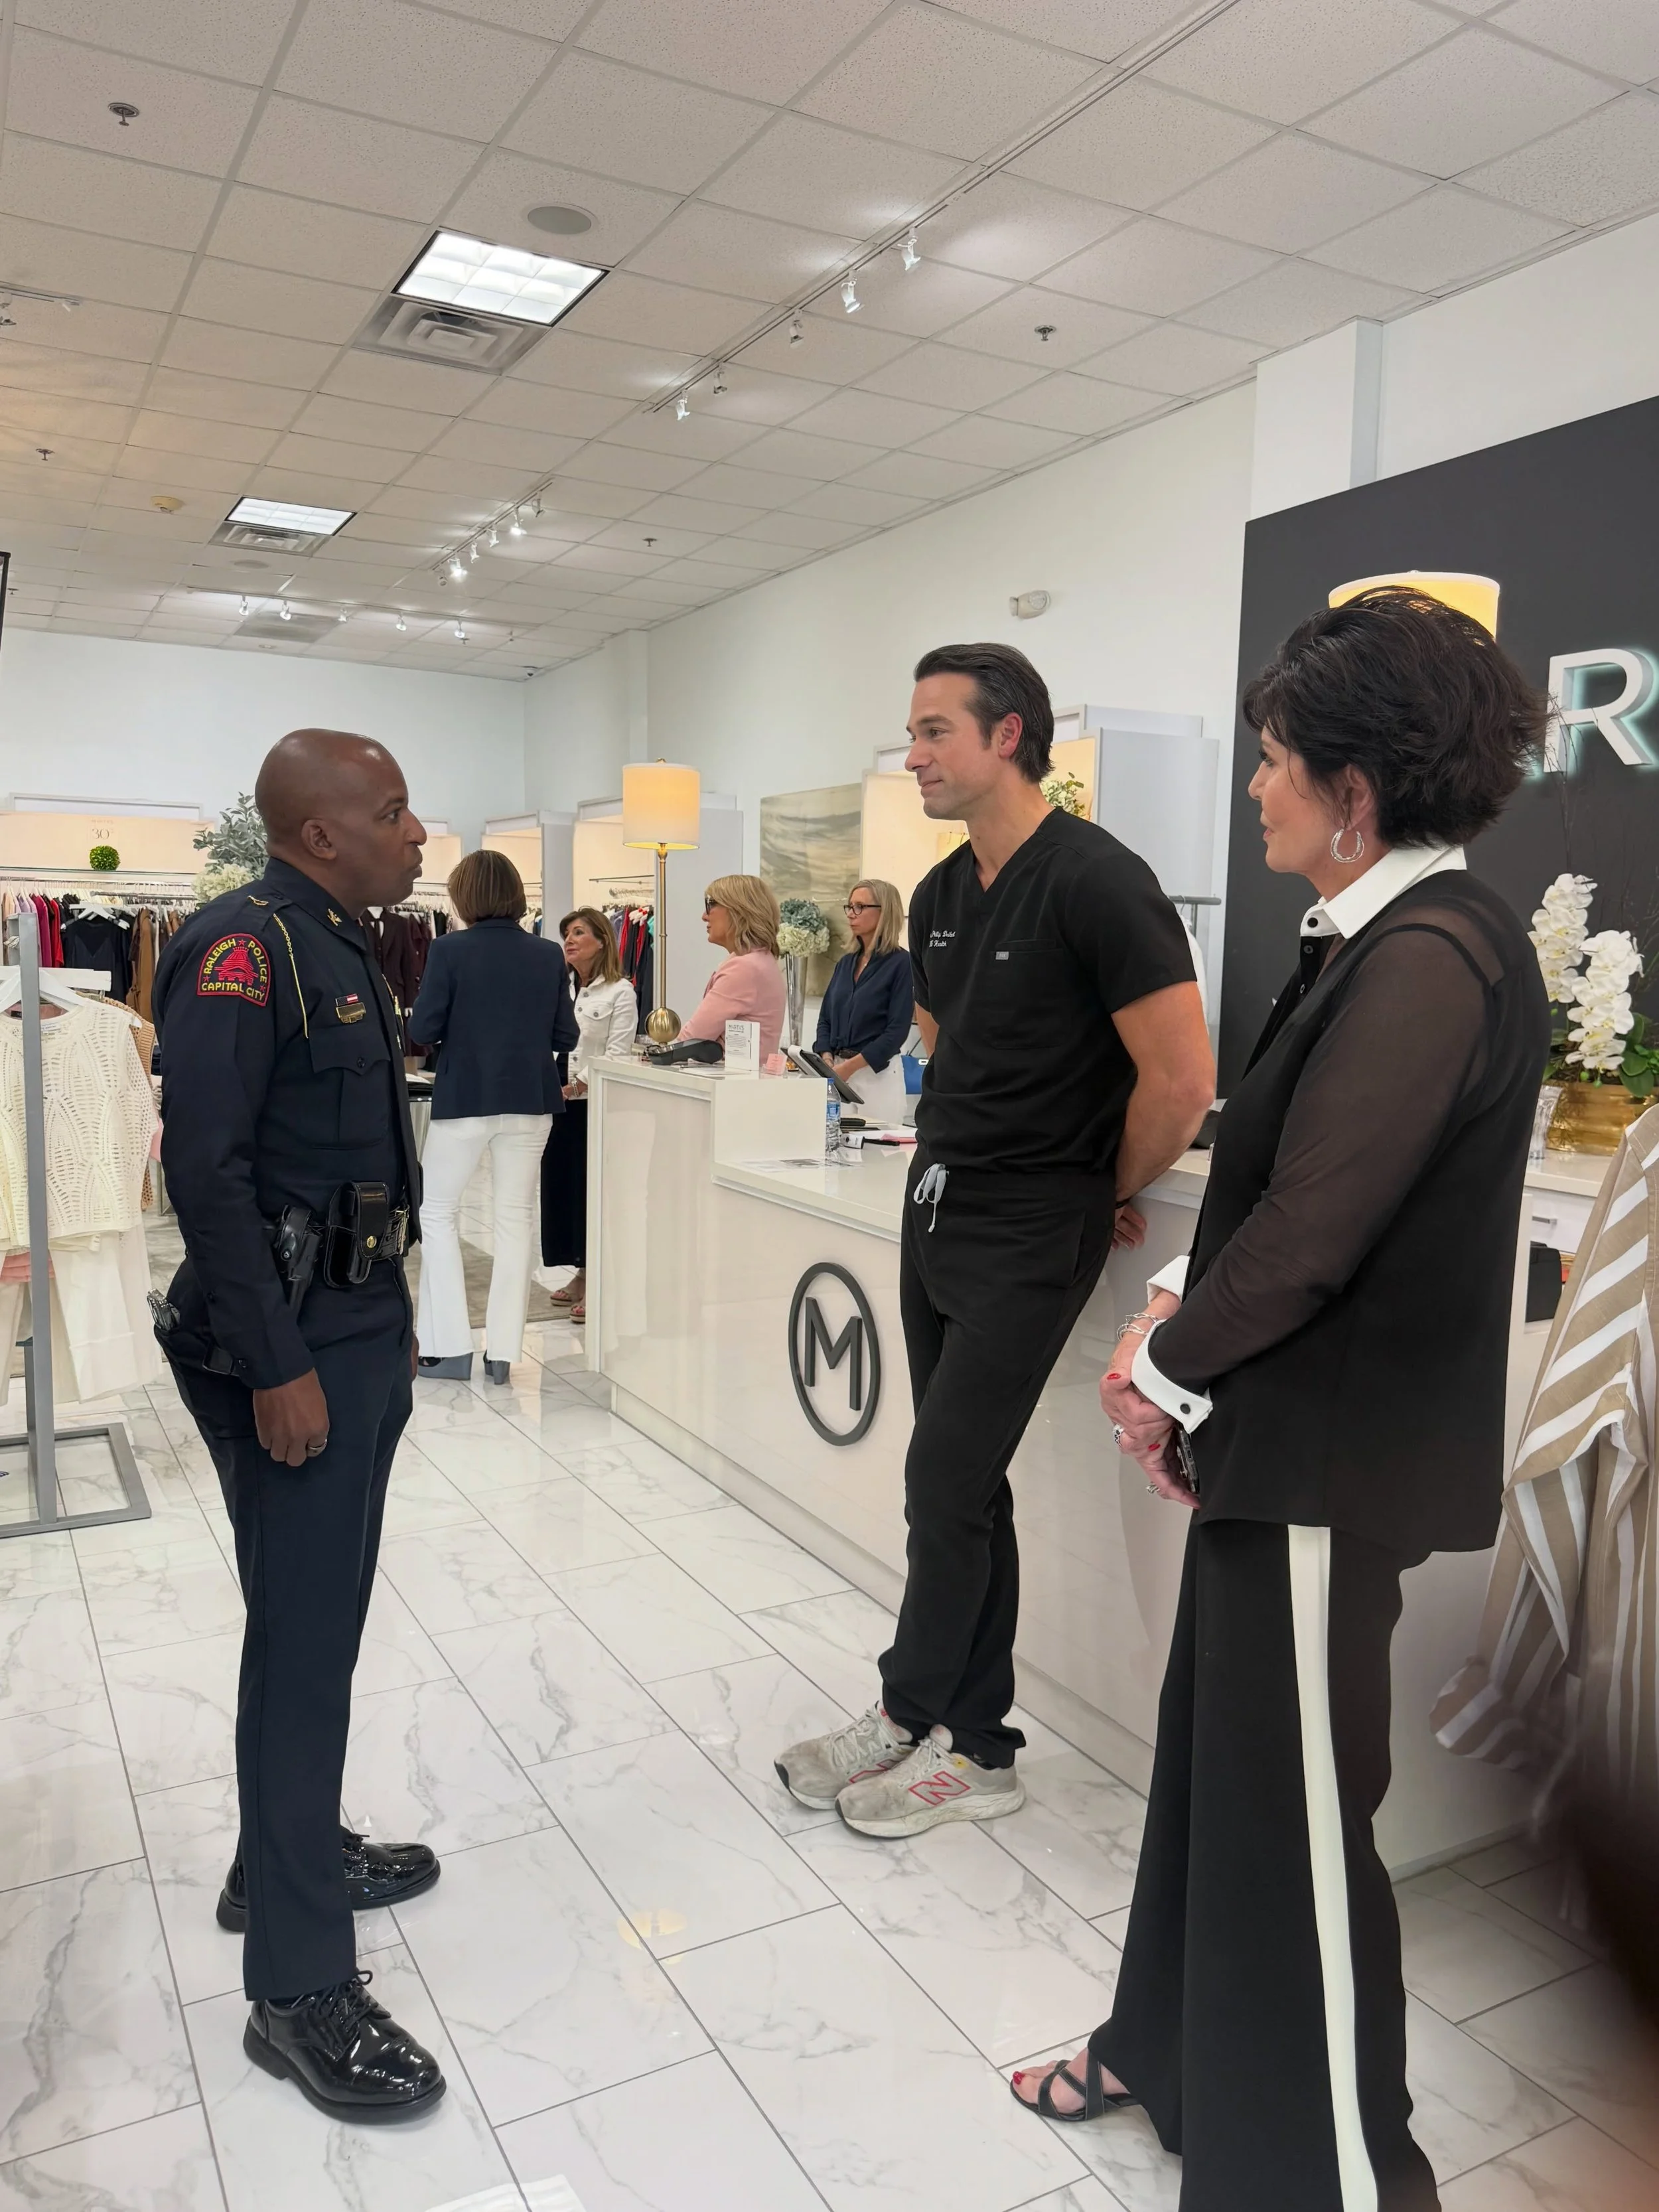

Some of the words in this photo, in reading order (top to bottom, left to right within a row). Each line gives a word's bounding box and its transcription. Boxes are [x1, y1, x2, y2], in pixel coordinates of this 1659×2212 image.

[204, 938, 236, 974] RALEIGH
[248, 940, 267, 984] POLICE
[202, 982, 244, 993] CAPITAL
[246, 987, 265, 1001] CITY
[804, 1296, 863, 1412] M
